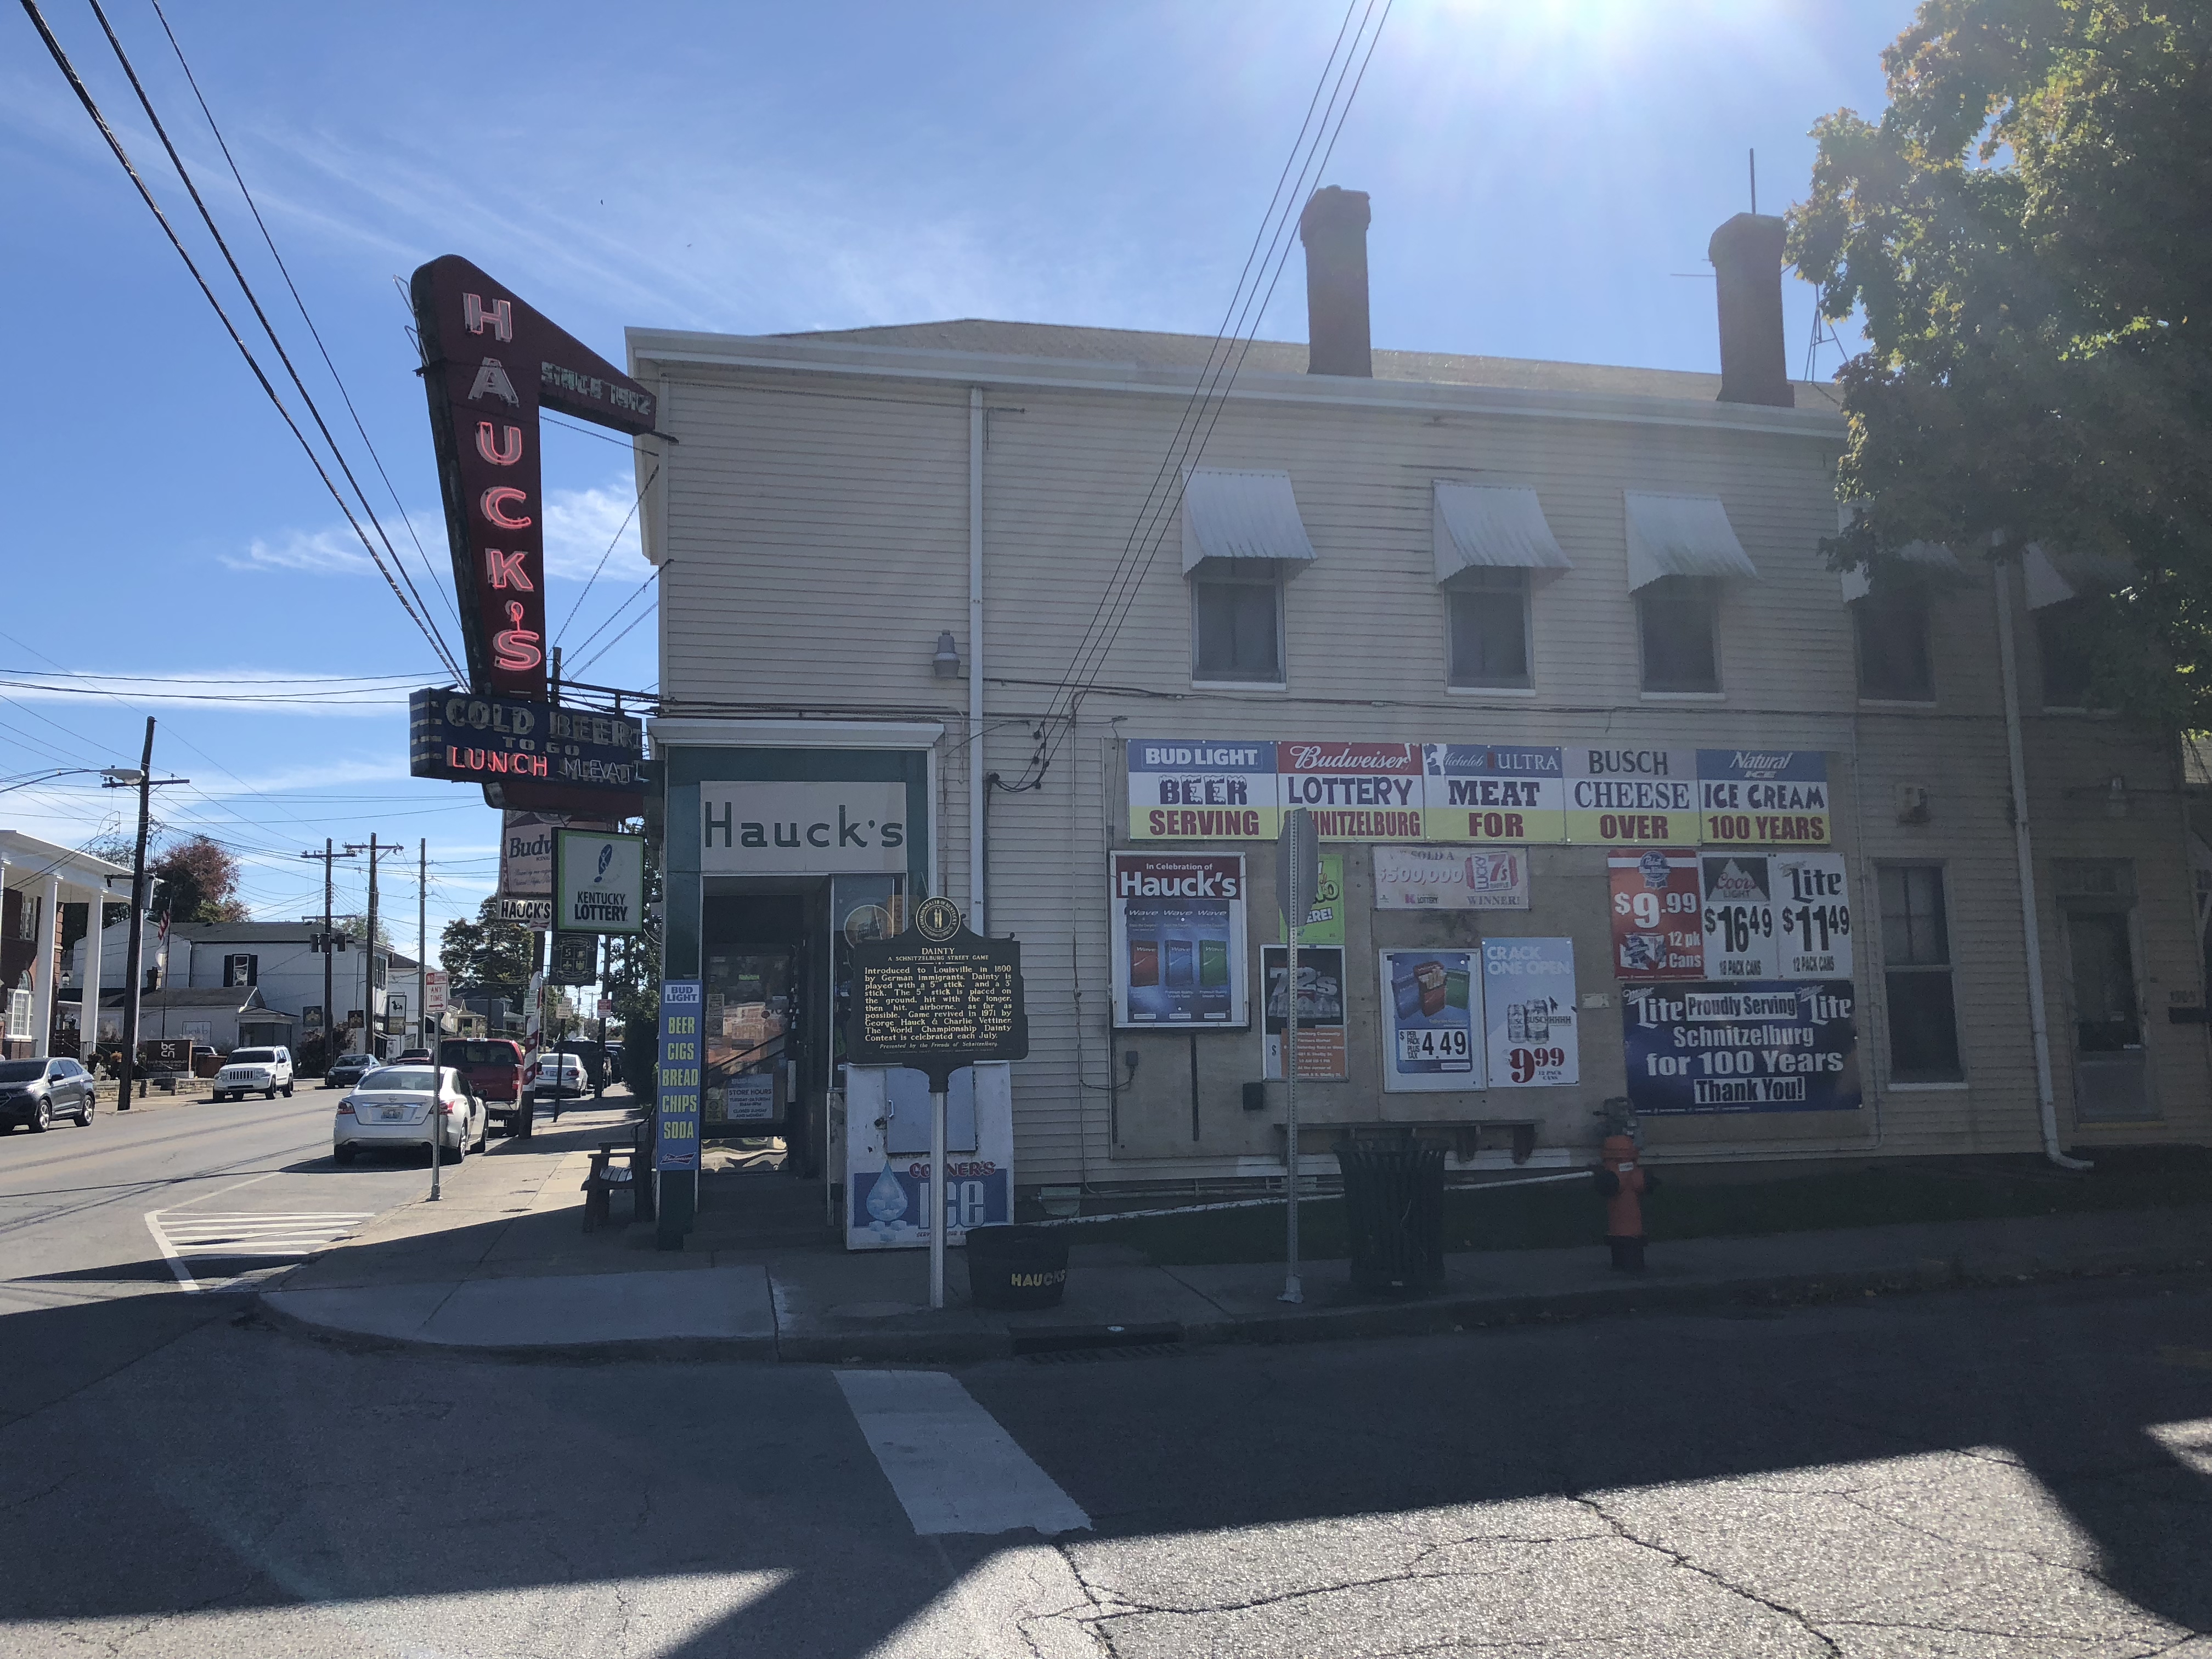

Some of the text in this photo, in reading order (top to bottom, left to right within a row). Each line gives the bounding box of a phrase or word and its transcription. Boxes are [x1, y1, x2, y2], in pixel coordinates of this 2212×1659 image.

[541, 361, 652, 415] SINCE 1912
[462, 292, 541, 672] HAUCK'S
[446, 698, 633, 748] COLD BEER
[502, 736, 580, 756] TO GO
[1146, 748, 1257, 765] BUD LIGHT
[1290, 745, 1410, 769] Budweiser
[447, 744, 634, 785] LUNCH MEAT
[1498, 754, 1560, 770] ULTRA
[1588, 750, 1668, 775] BUSCH
[1729, 751, 1794, 769] Natural
[1159, 774, 1248, 805] BEER
[1288, 776, 1413, 805] LOTTERY
[1448, 780, 1541, 808] MEAT
[1574, 781, 1690, 810] CHEESE
[1703, 783, 1825, 809] ICE CREAM
[704, 802, 904, 848] Hauck's
[1149, 810, 1260, 837] SERVING
[1284, 810, 1420, 837] HNITZELBURG
[1468, 812, 1525, 838] FOR
[1599, 814, 1669, 840] OVER
[1708, 815, 1825, 840] 100 YEARS
[1121, 871, 1237, 896] Hauck's
[1474, 855, 1489, 890] LUCKY
[1716, 872, 1756, 889] Coors
[1791, 868, 1842, 904] Lite
[577, 891, 626, 905] KENTUCKY
[1417, 896, 1439, 904] LOTTERY
[500, 901, 551, 919] HAUCK'S
[574, 904, 629, 922] LOTTERY
[1307, 908, 1333, 924] ERE!
[1614, 892, 1697, 928] $9.99
[1668, 931, 1701, 948] 12 pk
[1487, 946, 1542, 960] CRACK
[1669, 953, 1701, 968] Cans
[427, 974, 434, 983] NO
[1488, 960, 1572, 975] ONE OPEN
[865, 981, 893, 991] played
[865, 1012, 900, 1020] possible.
[1635, 996, 1683, 1029] Lite
[1688, 995, 1796, 1017] Proudly Serving
[1809, 994, 1852, 1025] Lite
[668, 1017, 695, 1034] BEER
[865, 1019, 894, 1028] George
[921, 1025, 977, 1034] Championship
[1399, 1030, 1466, 1059] $ 4.49
[1673, 1024, 1814, 1047] Schnitzelburg
[667, 1042, 695, 1060] CIGS
[1646, 1050, 1844, 1076] for 100 Years
[662, 1068, 698, 1086] BREAD
[1696, 1077, 1803, 1103] Thank You!
[662, 1094, 697, 1113] CHIPS
[663, 1121, 695, 1139] SODA
[909, 1161, 997, 1178] CONER'S
